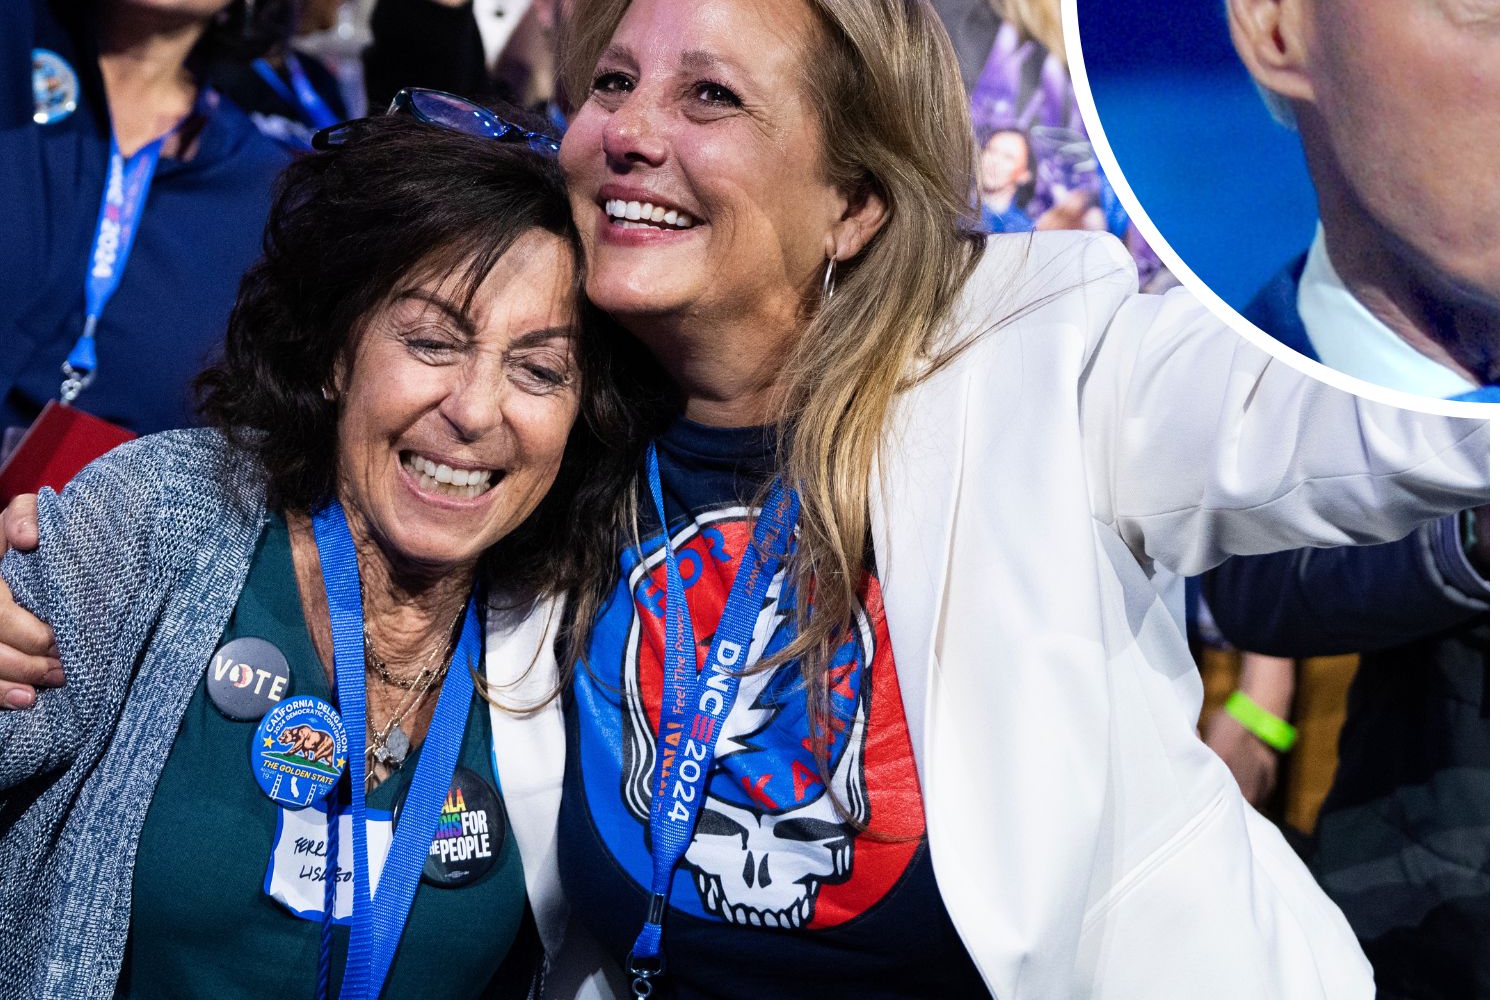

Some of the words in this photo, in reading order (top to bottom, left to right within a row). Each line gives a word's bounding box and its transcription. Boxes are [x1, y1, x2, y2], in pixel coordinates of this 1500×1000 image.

[636, 527, 733, 619] FOR
[214, 655, 287, 702] VOTE
[674, 656, 686, 681] The
[699, 639, 742, 716] DNC
[672, 685, 686, 714] Feel
[266, 699, 314, 733] CALIFORNIA
[317, 701, 348, 753] DELEGATION
[273, 720, 286, 735] 2024
[285, 708, 323, 721] DEMOCRATIC
[323, 715, 341, 754] CONVENTION
[262, 759, 279, 770] THE
[279, 764, 311, 779] GOLDEN
[310, 773, 335, 785] STATE
[667, 739, 707, 823] 2024
[461, 810, 488, 835] FOR
[440, 834, 492, 863] PEOPLE
